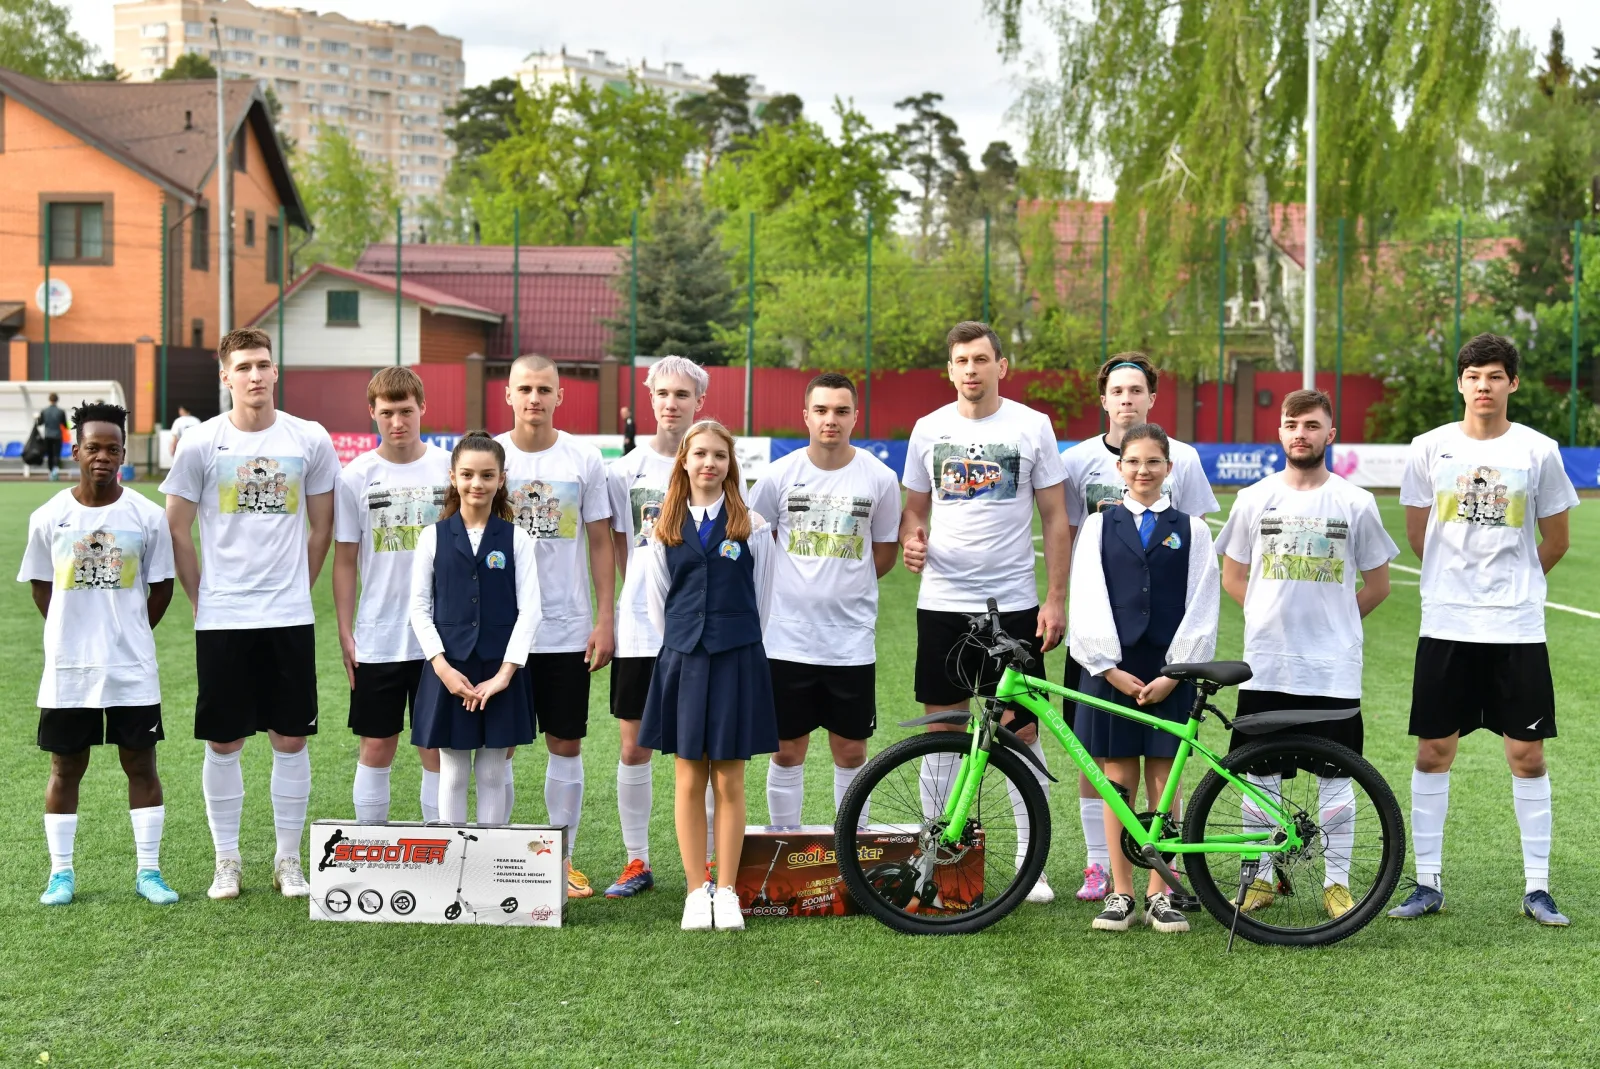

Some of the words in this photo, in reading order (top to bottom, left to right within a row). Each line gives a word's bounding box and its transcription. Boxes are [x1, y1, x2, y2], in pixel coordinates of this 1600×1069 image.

[1046, 708, 1110, 788] EQUIVALENT
[334, 838, 452, 865] SCOOTER
[788, 848, 820, 864] cool
[825, 846, 883, 863] ster
